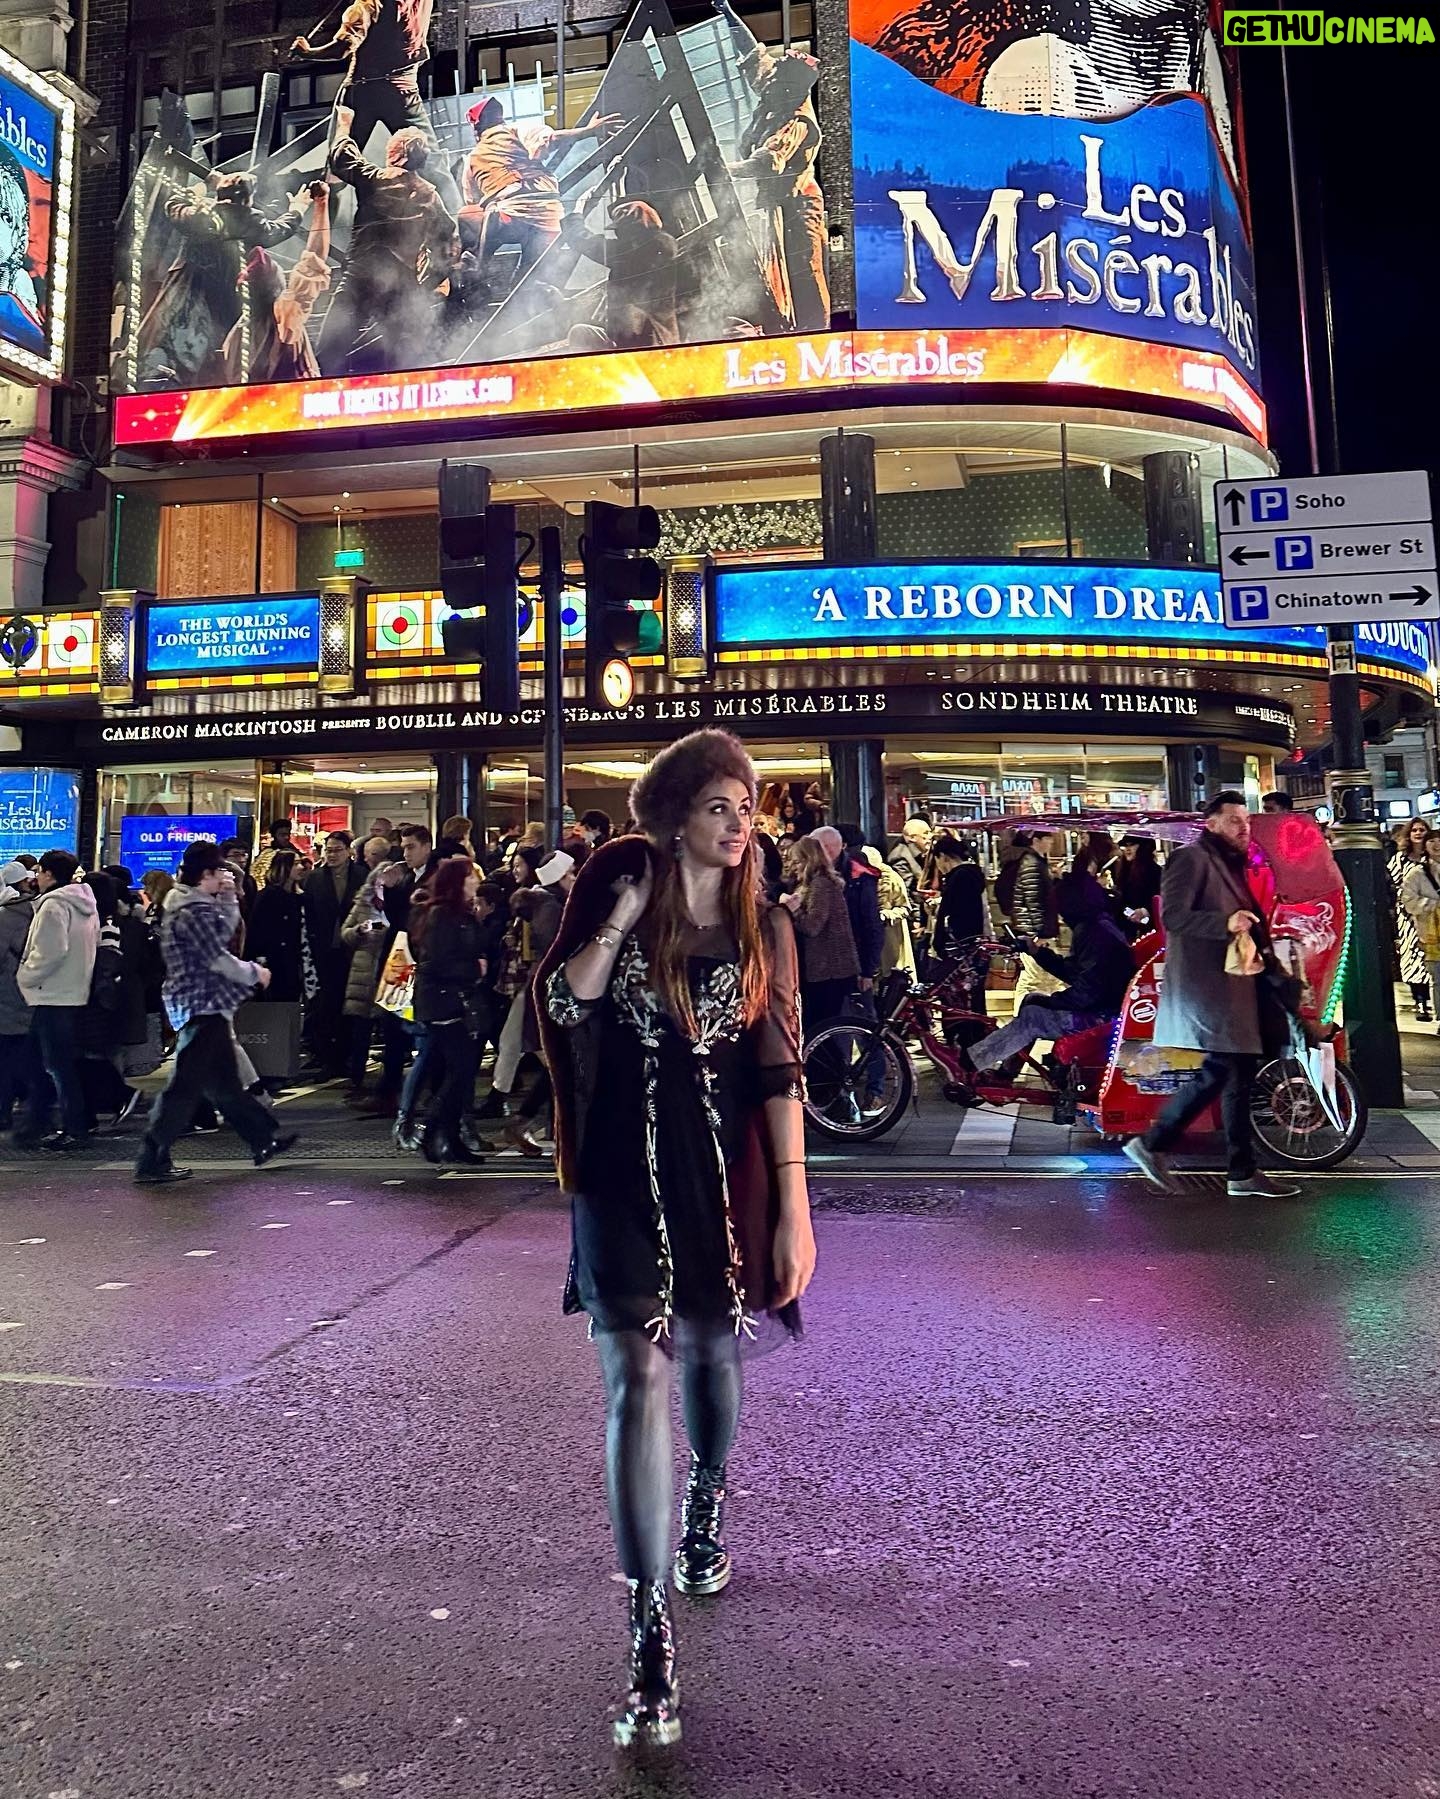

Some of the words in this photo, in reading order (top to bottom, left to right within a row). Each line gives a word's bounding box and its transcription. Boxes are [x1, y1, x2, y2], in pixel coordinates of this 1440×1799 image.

[0, 107, 47, 168] ables
[1079, 134, 1187, 237] Les
[888, 188, 1255, 370] Misérables
[723, 349, 786, 388] Les
[797, 335, 985, 382] Misérables
[402, 384, 420, 409] AT
[1295, 493, 1346, 510] Soho
[1320, 542, 1391, 558] Brewer
[1399, 538, 1424, 554] St
[864, 584, 1075, 620] REBORN
[1275, 591, 1384, 608] Chinatown
[180, 617, 212, 632] THE
[216, 613, 288, 630] WORLD'S
[157, 630, 230, 647] LONGEST
[235, 626, 311, 643] RUNNING
[197, 642, 270, 658] MUSICAL
[941, 692, 1092, 711] SONDHEIM
[1100, 693, 1199, 715] THEATRE
[102, 724, 188, 742] CAMERON
[194, 719, 316, 738] MACKINTOSH
[321, 718, 371, 730] PRESENTS
[375, 712, 456, 730] BOUBLIL
[461, 712, 503, 727] AND
[510, 704, 645, 725] SCHNBERG'S
[655, 700, 701, 719] LES
[714, 693, 886, 716] MISÉRABLES
[8, 801, 31, 816] Les
[0, 810, 67, 831] sérables
[140, 832, 163, 842] OLD
[167, 832, 217, 843] FRIENDS
